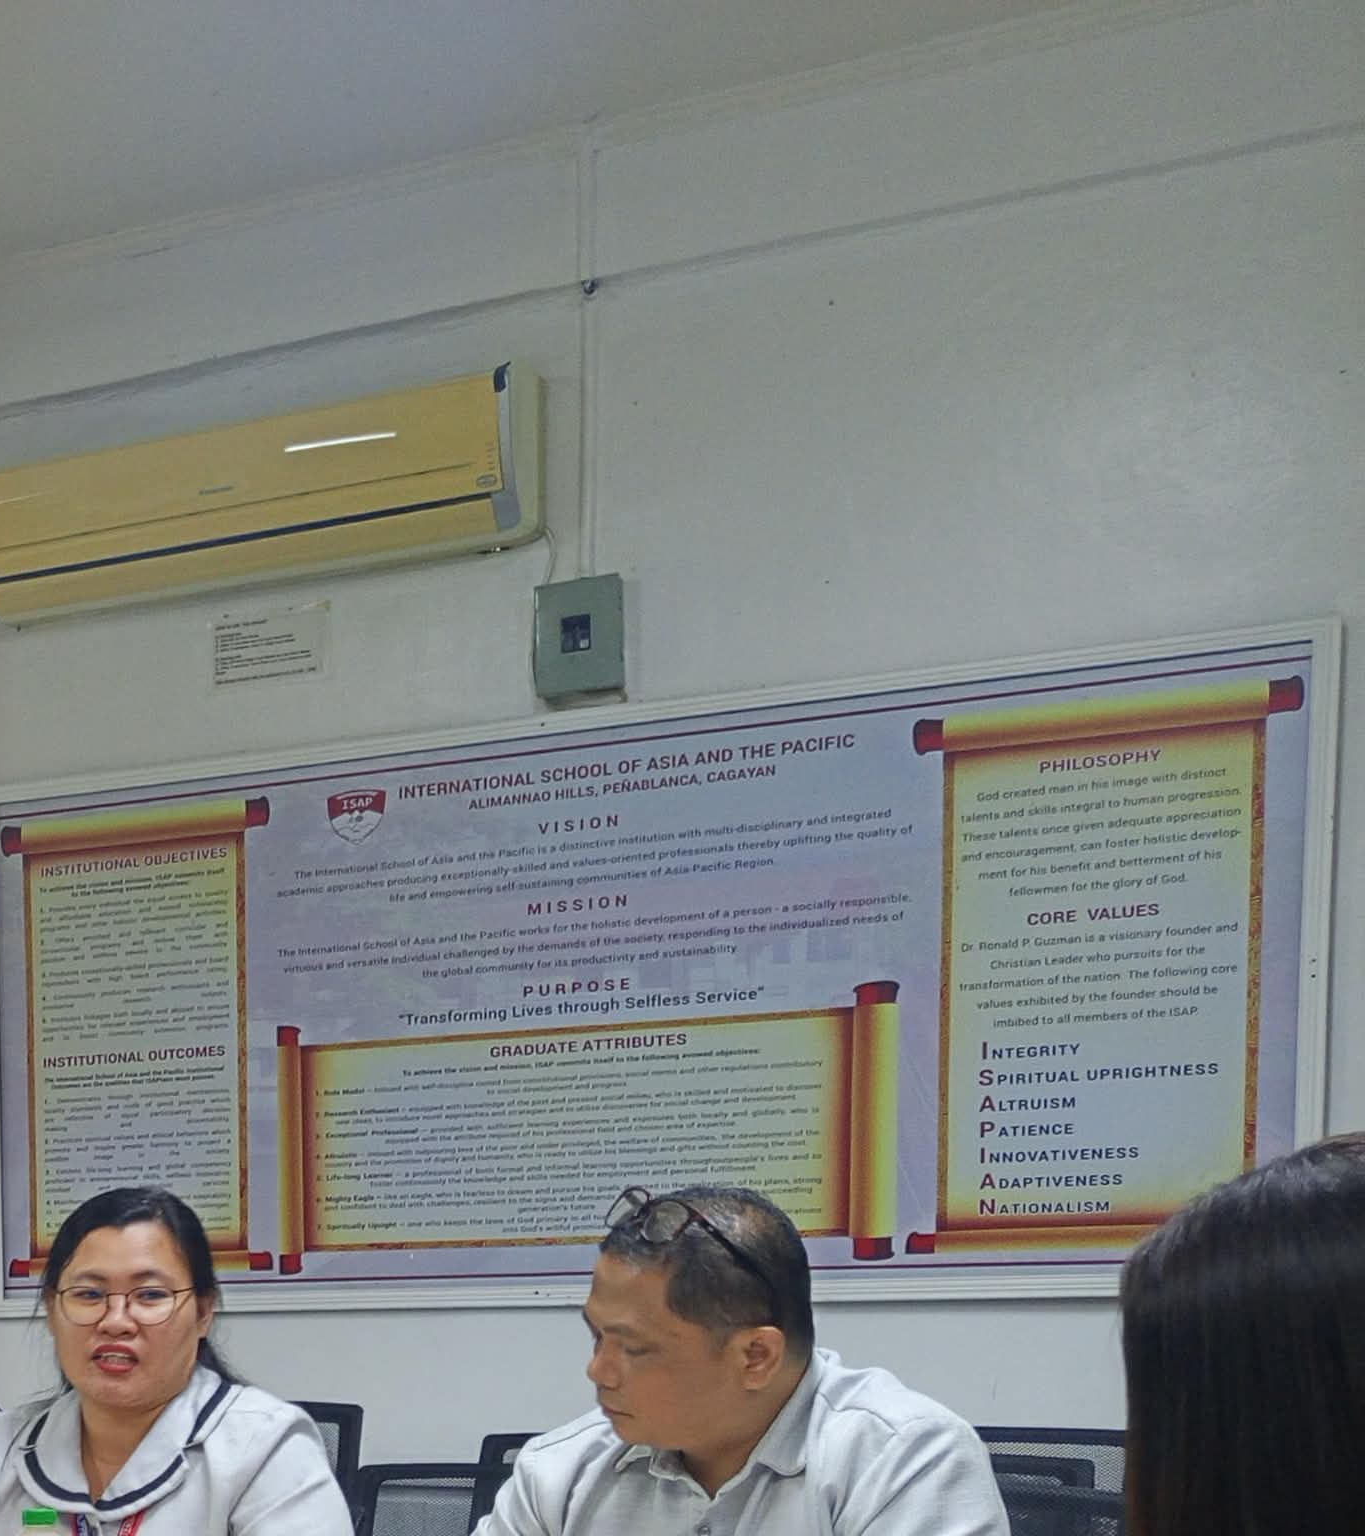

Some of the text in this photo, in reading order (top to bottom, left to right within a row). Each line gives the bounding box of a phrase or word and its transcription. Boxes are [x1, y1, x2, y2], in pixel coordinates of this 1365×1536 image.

[398, 734, 855, 800] INTERNATIONAL SCHOOL OF ASIA AND THE PACIFIC
[1039, 750, 1161, 774] PHILOSOPHY
[469, 765, 775, 810] ALIMANNAO HILLS, PEÑABLANCA, CAGAYAN
[977, 791, 999, 802] God
[1002, 785, 1045, 800] created
[1049, 785, 1074, 794] man
[1091, 781, 1109, 790] his
[1112, 777, 1148, 787] image
[1152, 773, 1177, 783] with
[1181, 768, 1226, 780] distinct
[341, 795, 373, 811] ISAP
[961, 812, 1000, 823] talents
[1003, 808, 1024, 819] and
[1028, 805, 1057, 816] skills
[1061, 800, 1105, 813] integral
[1108, 800, 1120, 808] to
[1123, 796, 1164, 806] human
[538, 816, 618, 834] VISION
[962, 808, 1241, 842] These talents once given adequate appreciation
[961, 852, 981, 862] and
[1081, 842, 1101, 851] can
[1106, 838, 1139, 848] foster
[1144, 832, 1186, 845] holistic
[42, 848, 226, 877] INSTITUTIONAL OBJECTIVES
[527, 895, 628, 916] MISSION
[1027, 903, 1159, 926] CORE VALUES
[522, 978, 630, 998] PURPOSE
[512, 1005, 552, 1017] Lives
[558, 997, 619, 1014] through
[625, 994, 690, 1008] Selfless
[44, 1046, 225, 1068] INSTITUTIONAL OUTCOMES
[490, 1034, 686, 1057] GRADUATE ATTRIBUTES
[981, 1041, 1080, 1060] INTEGRITY
[979, 1063, 1219, 1086] SPIRITUAL UPRIGHTNESS
[979, 1095, 1077, 1112] ALTRUISM
[979, 1121, 1075, 1138] PATIENCE
[980, 1146, 1139, 1164] INNOVATIVENESS
[979, 1173, 1123, 1190] ADAPTIVENESS
[979, 1198, 1110, 1216] NATIONALISM
